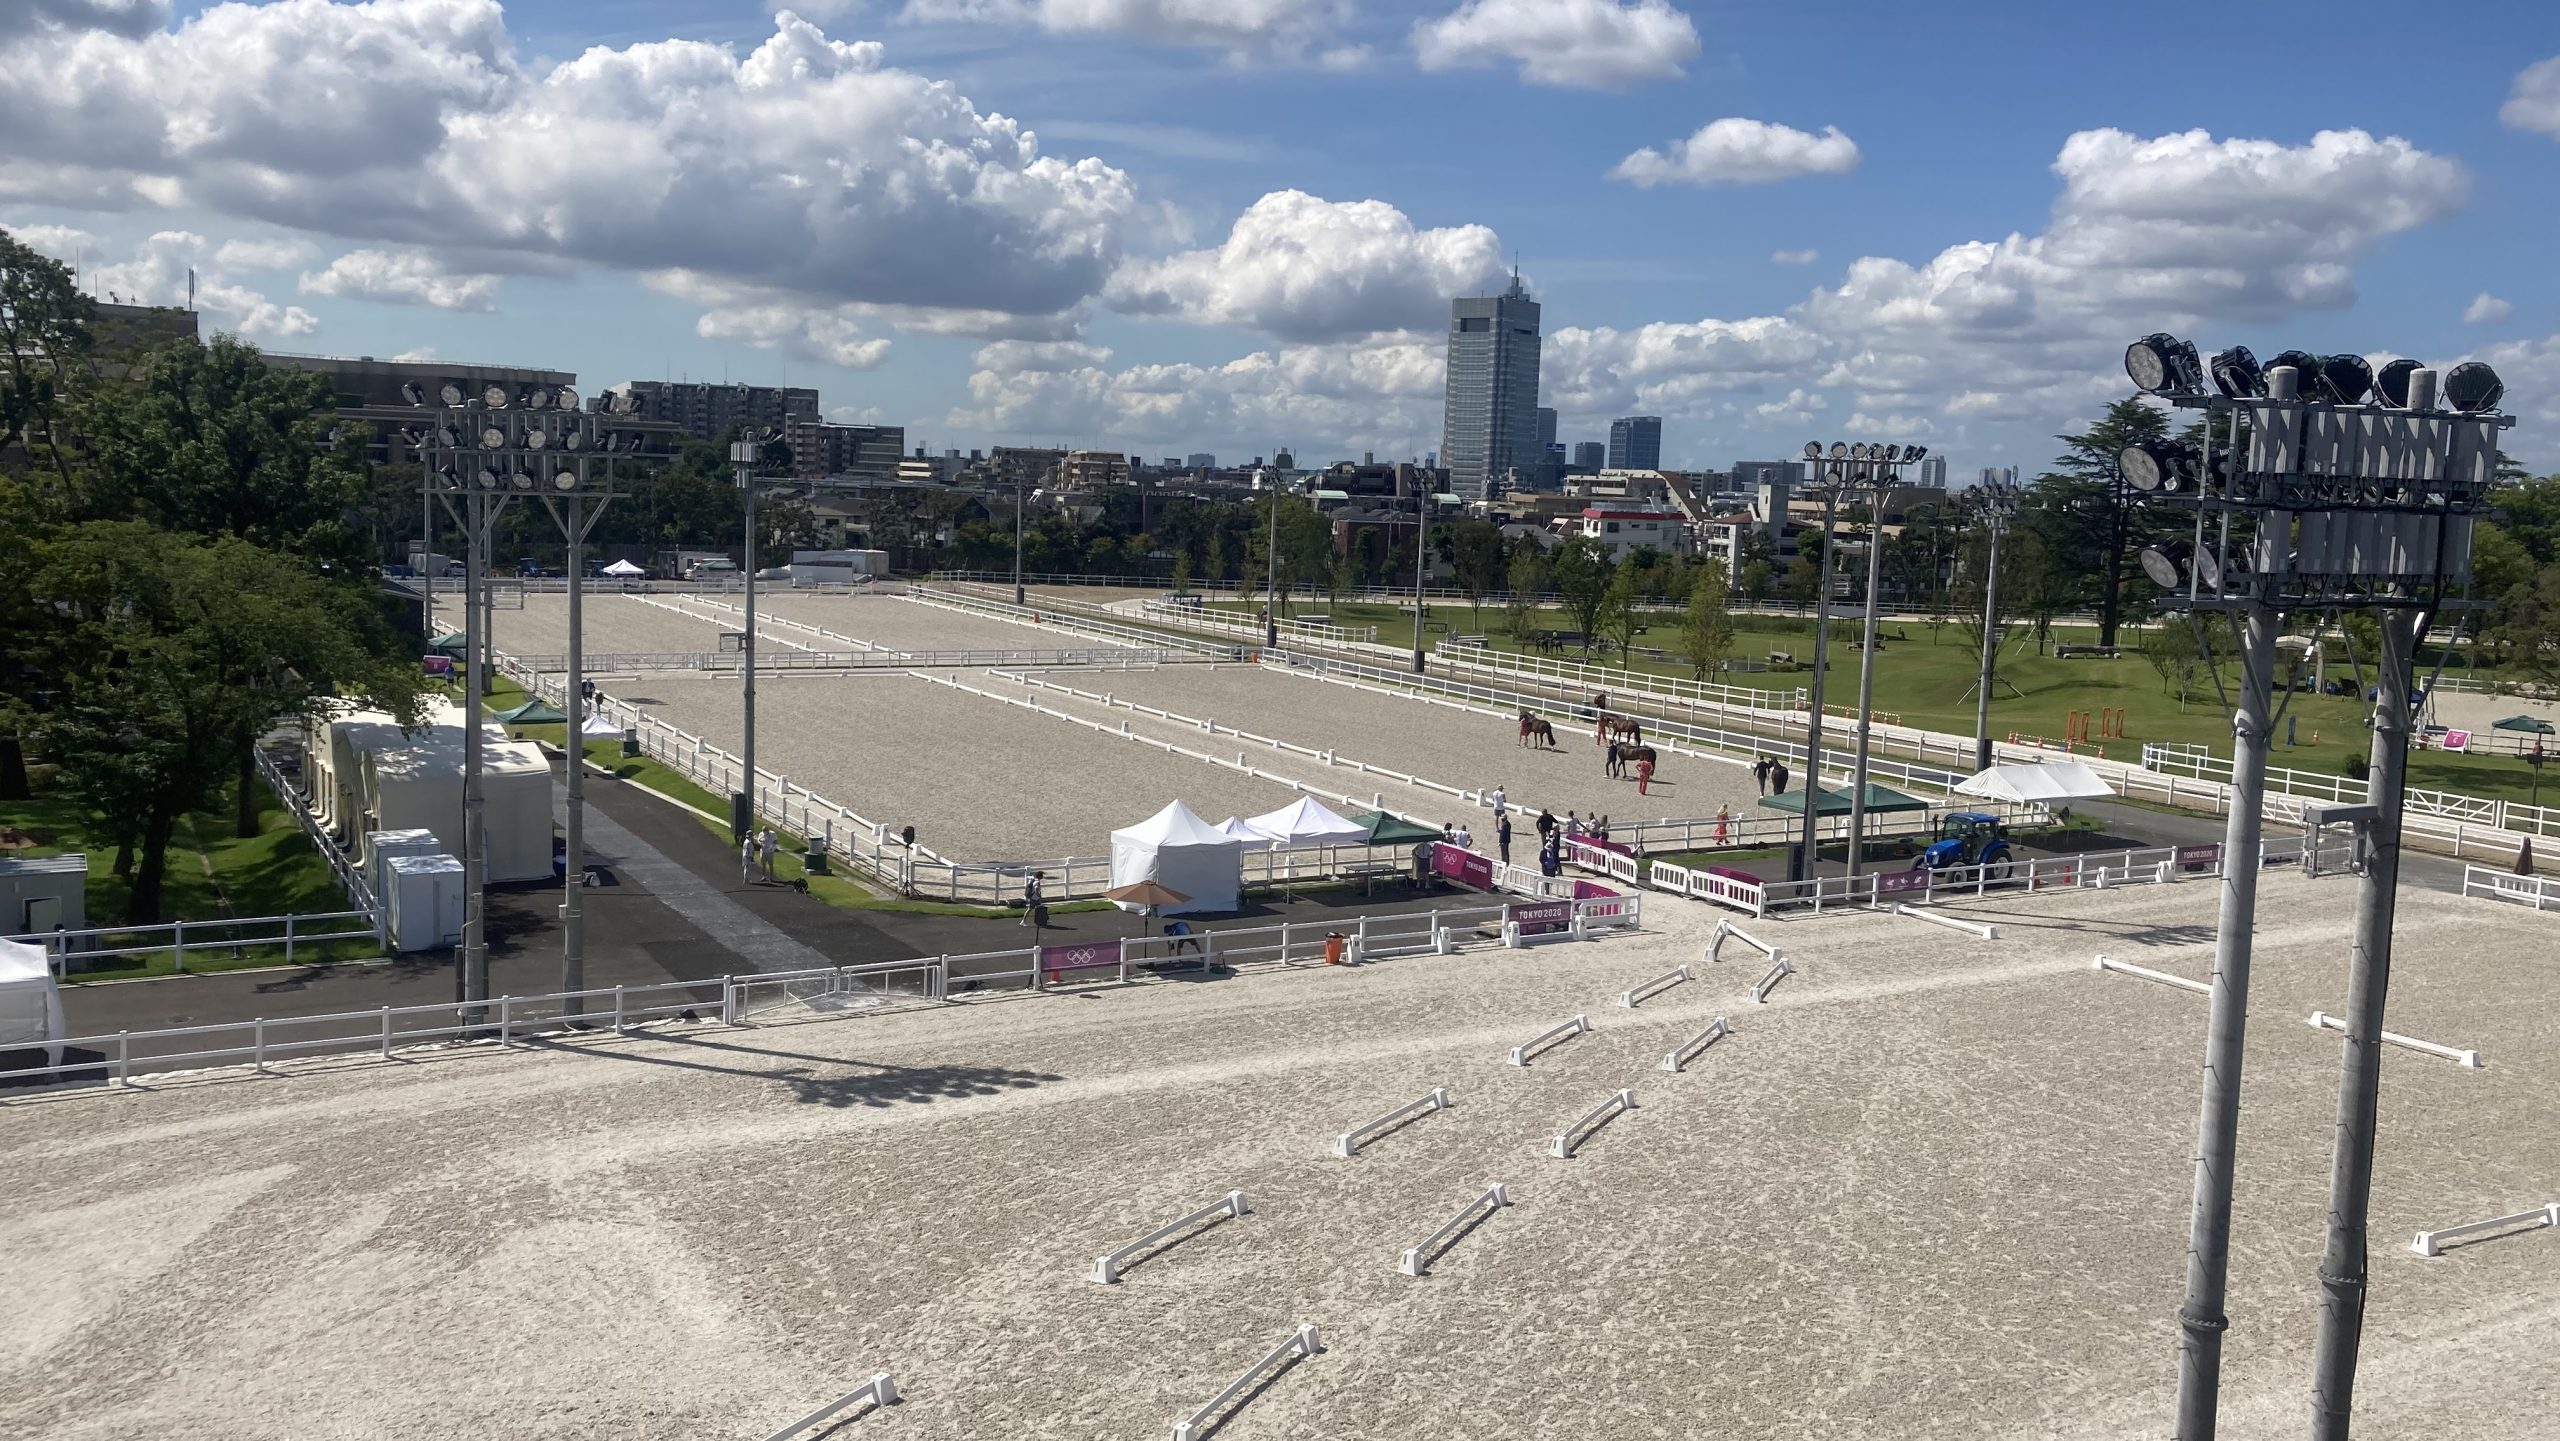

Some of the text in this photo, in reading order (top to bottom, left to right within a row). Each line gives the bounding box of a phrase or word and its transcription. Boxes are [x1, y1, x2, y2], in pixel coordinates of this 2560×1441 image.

[2183, 850, 2213, 859] TOKYO 2020
[1466, 860, 1488, 874] TOKYO 2020
[1518, 908, 1562, 920] TOKYO 2020
